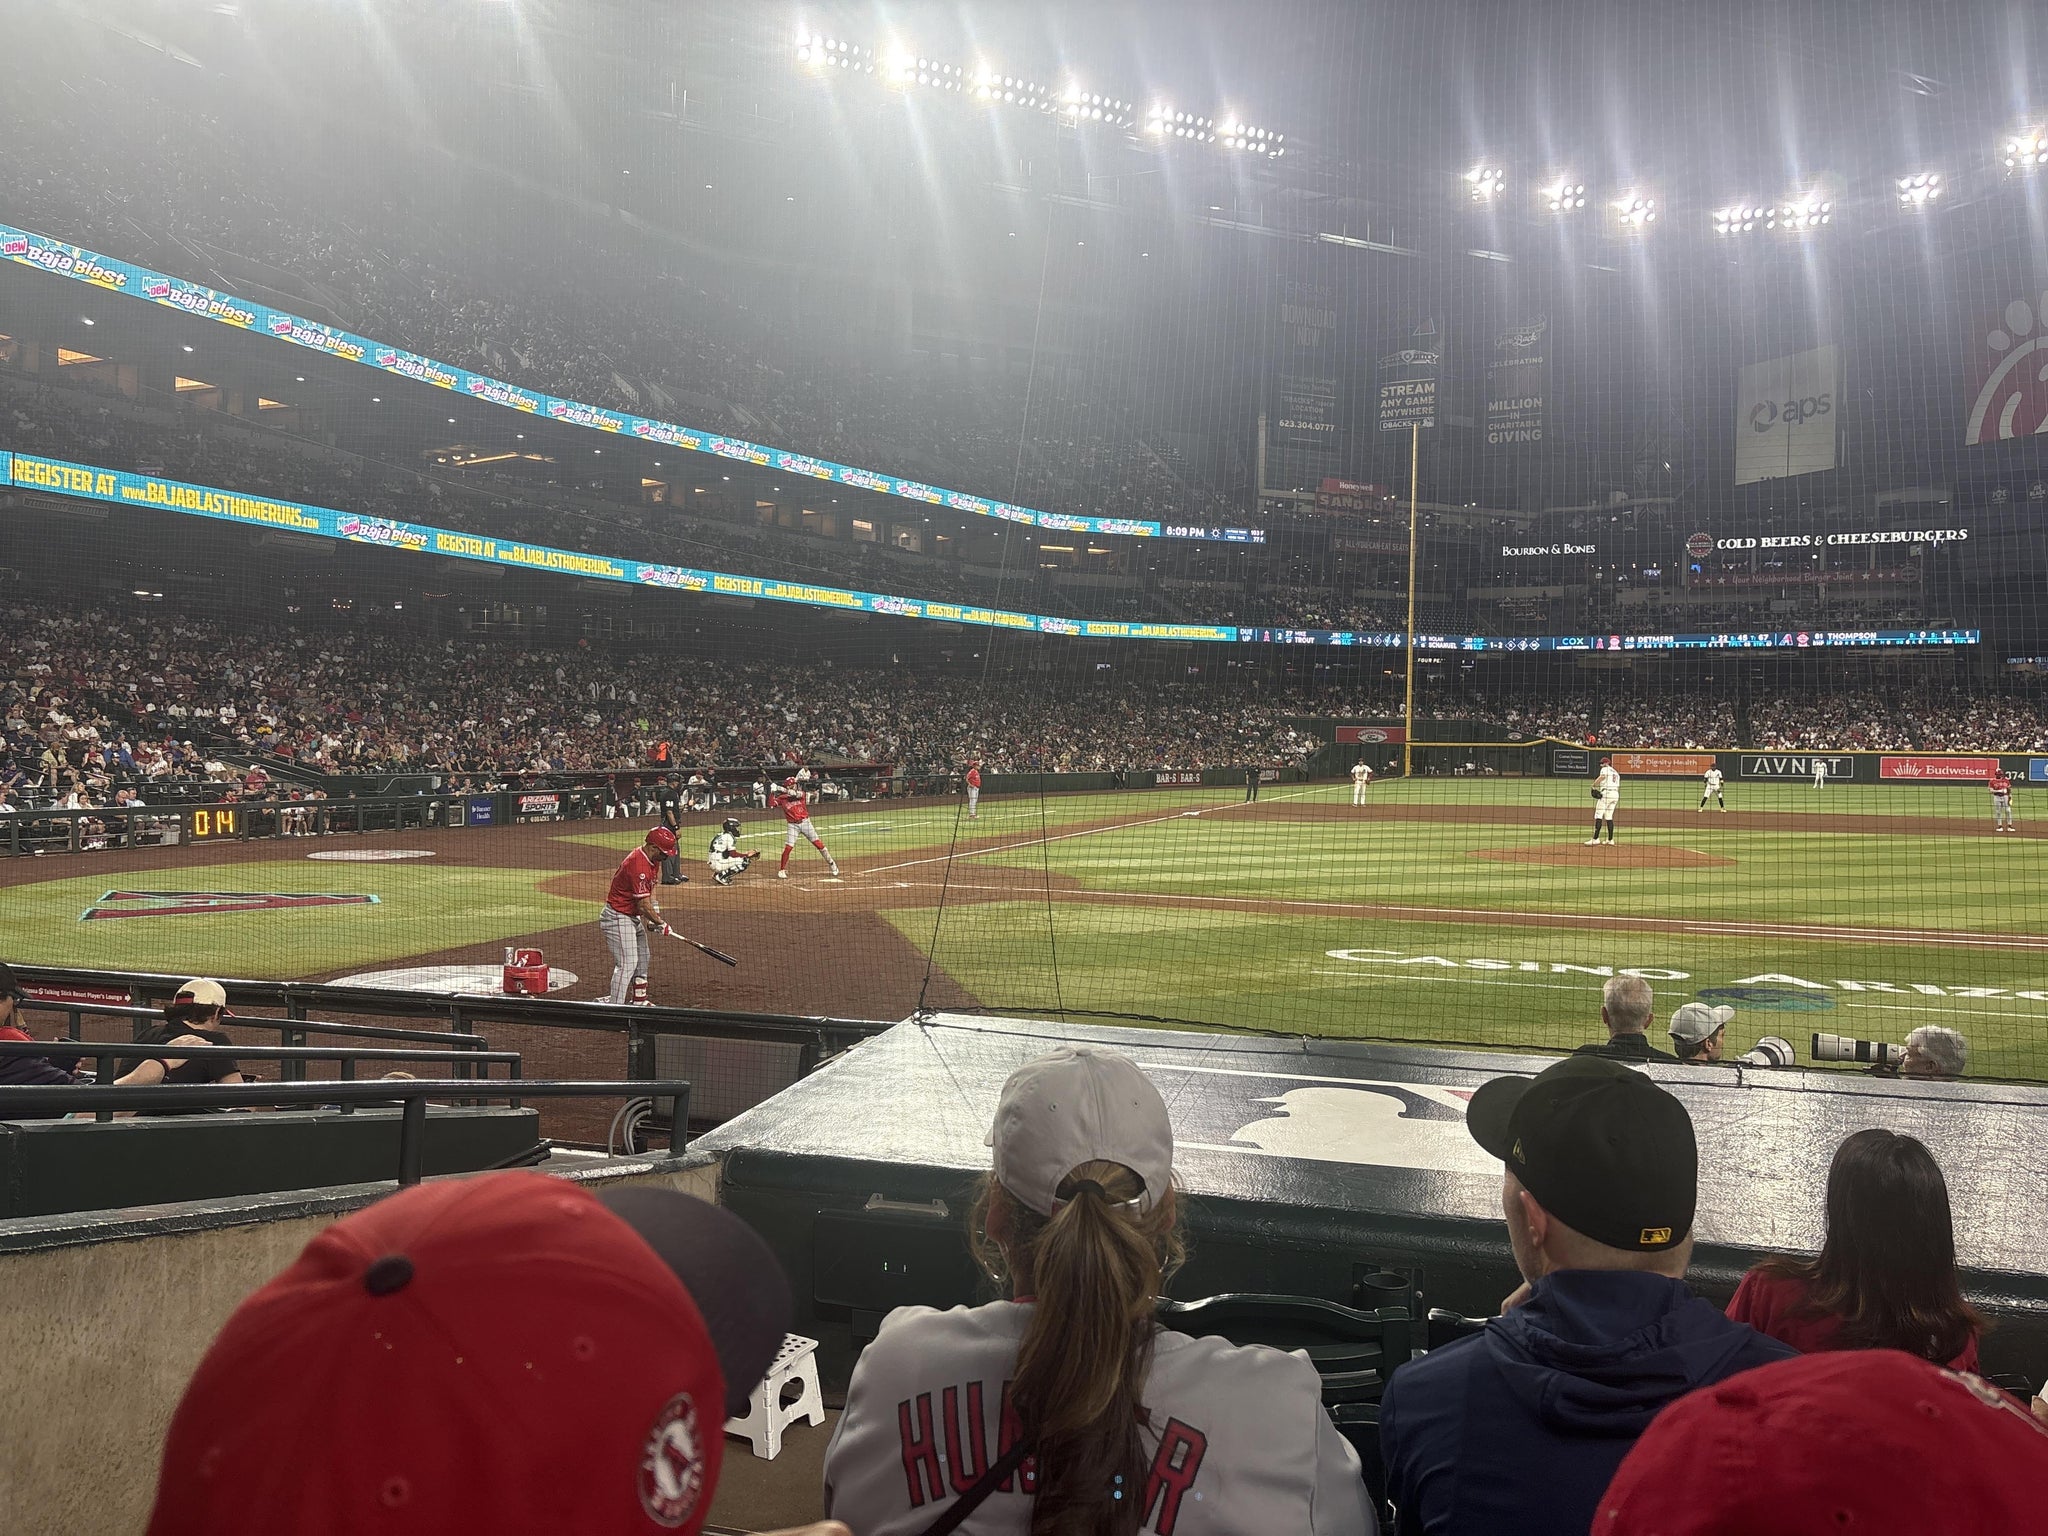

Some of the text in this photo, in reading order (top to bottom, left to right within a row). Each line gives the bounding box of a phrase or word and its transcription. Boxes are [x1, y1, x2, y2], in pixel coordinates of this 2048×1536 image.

[27, 246, 72, 270] Baja
[74, 259, 127, 286] Blast
[169, 289, 208, 310] Baja
[209, 301, 256, 324] Blast
[291, 325, 324, 345] Baja
[325, 337, 365, 358] Blast
[1489, 356, 1544, 368] CELEBRATING
[396, 358, 458, 386] Baja Blast
[1380, 382, 1435, 398] STREAM
[483, 385, 539, 410] Baja Blast
[1380, 395, 1435, 409] ANY GAME
[1488, 397, 1543, 412] MILLION
[1380, 406, 1435, 418] ANYWHERE
[1510, 411, 1520, 420] IN
[1782, 393, 1831, 425] aps
[565, 408, 623, 429] Baja Blast
[1279, 419, 1335, 432] 623.304.0777
[1488, 419, 1542, 431] CHARITABLE
[648, 426, 701, 447] Baja Blast
[1488, 429, 1543, 444] GIVING
[724, 444, 770, 463] Baja Blast
[10, 458, 92, 492] REGISTER
[96, 474, 117, 496] AT
[1339, 481, 1374, 492] Honeywell
[1166, 526, 1205, 537] 8:09 PM
[358, 524, 390, 540] Baja
[391, 530, 428, 546] Blast
[437, 533, 482, 555] REGISTER
[483, 542, 496, 558] AT
[1717, 537, 1756, 550] COLD
[1760, 535, 1811, 548] BEERS
[1814, 535, 1824, 546] &
[1827, 528, 1968, 546] CHEESEBURGERS
[1502, 543, 1596, 556] BOURBON & BONES
[652, 571, 678, 584] Baja
[678, 575, 708, 587] Blast
[714, 575, 751, 593] REGISTER
[752, 581, 763, 595] AT
[1732, 570, 1853, 585] Your Neighborhood Burger Joint
[1240, 628, 1253, 636] DUE
[1637, 635, 1674, 643] DETMERS
[1828, 632, 1877, 640] THOMPSON
[1562, 637, 1584, 645] COX
[1646, 758, 1697, 768] Dignity Health
[1926, 765, 1988, 776] Budweiser
[2005, 770, 2025, 780] 374
[1156, 773, 1177, 783] BAR-S
[521, 795, 556, 803] ARIZONA
[523, 803, 558, 811] SPORTS
[476, 812, 491, 820] Health
[1325, 949, 1690, 980] CASINO
[44, 988, 60, 997] Talking
[105, 994, 122, 1002] Lounge
